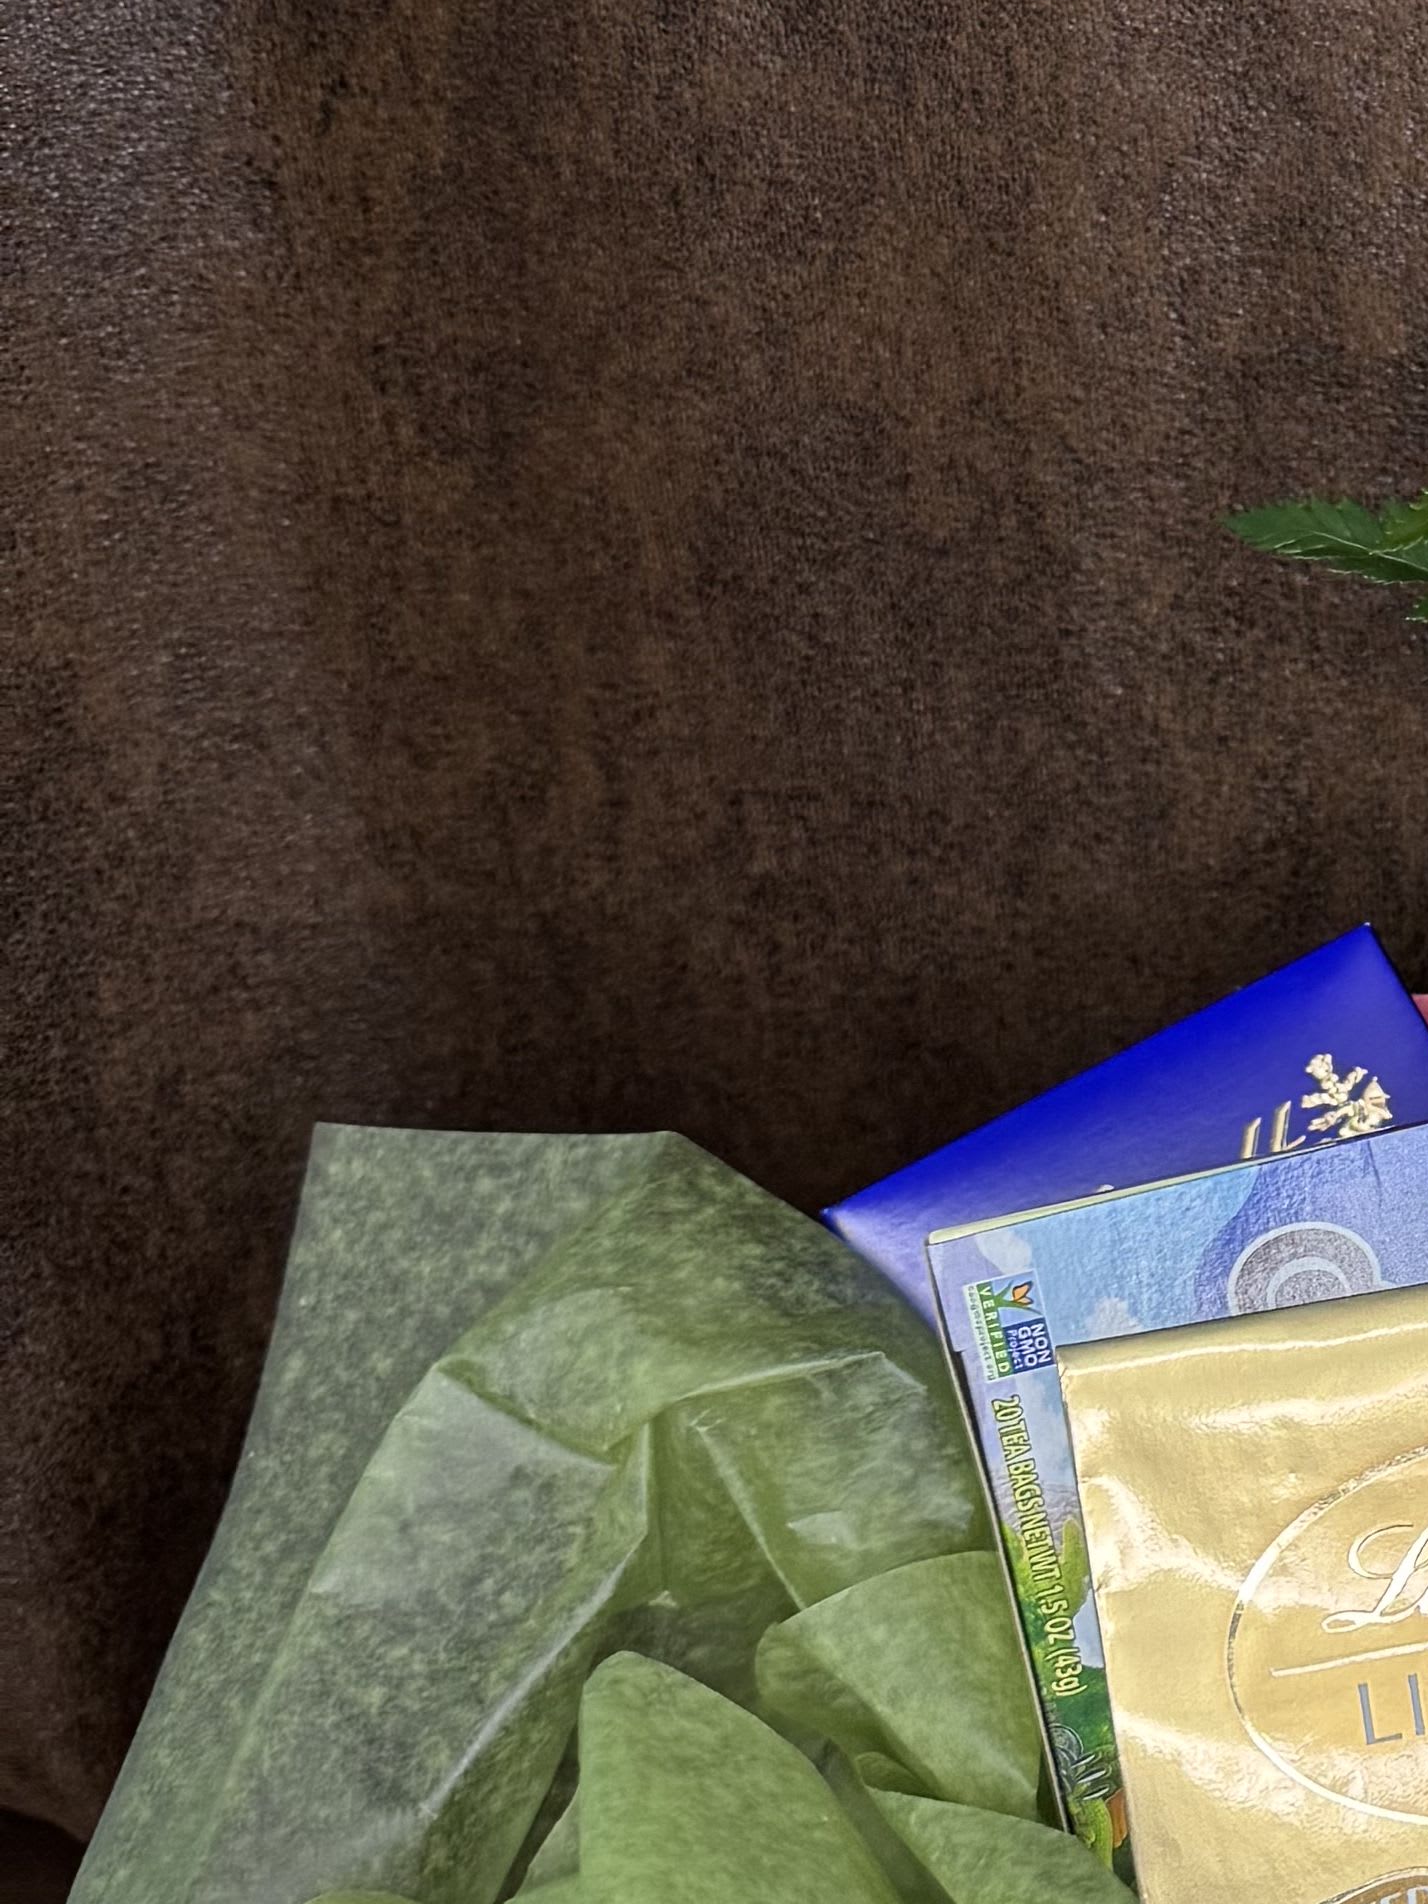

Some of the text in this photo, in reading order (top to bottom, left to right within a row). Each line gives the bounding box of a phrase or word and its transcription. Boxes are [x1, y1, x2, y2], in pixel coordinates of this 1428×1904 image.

[978, 1285, 1011, 1372] VERIFIED
[1015, 1325, 1039, 1367] GMO
[1029, 1321, 1053, 1363] NON
[988, 1392, 1025, 1423] 20
[996, 1417, 1033, 1463] TEA
[1004, 1456, 1047, 1514] BAGS
[1017, 1509, 1057, 1555] NET
[1034, 1581, 1071, 1620] 1.5
[1043, 1614, 1077, 1646] OZ
[1044, 1644, 1089, 1700] (43g)
